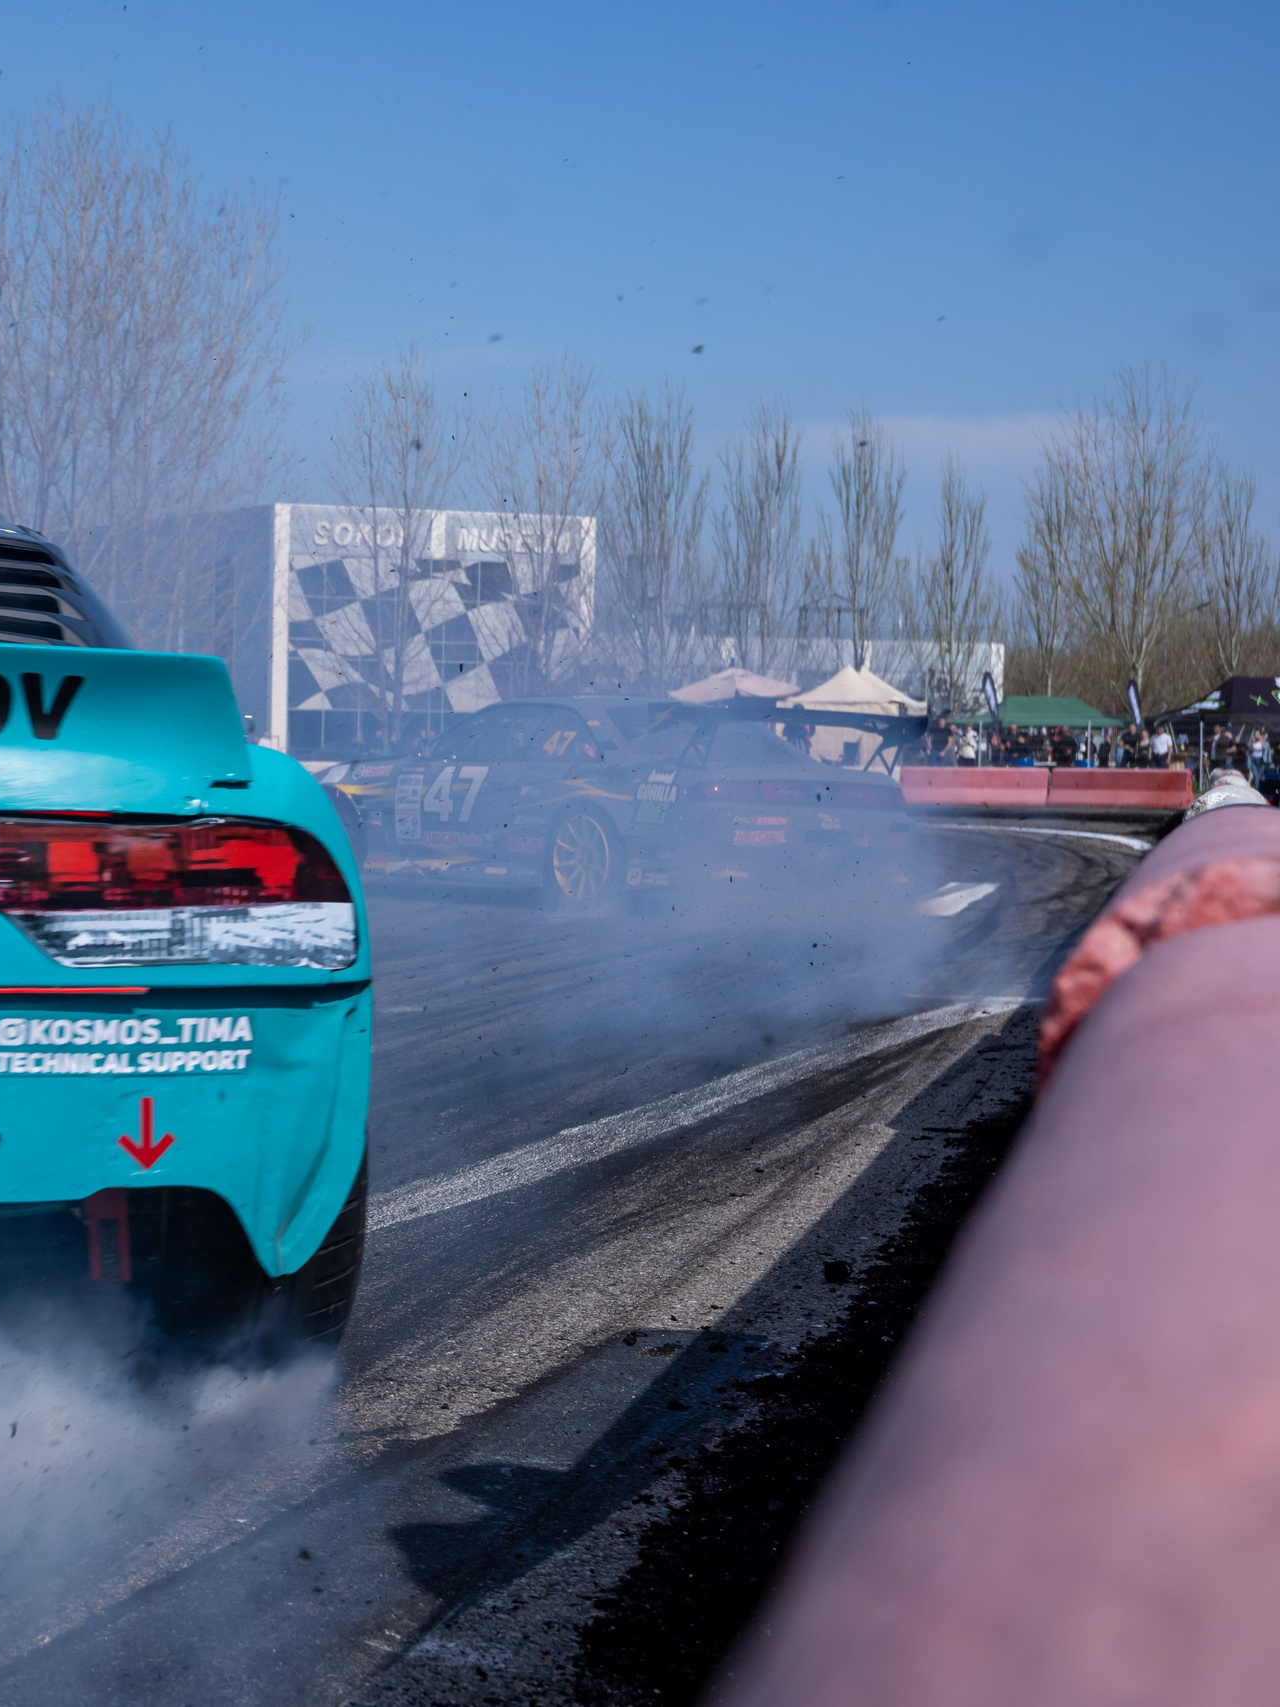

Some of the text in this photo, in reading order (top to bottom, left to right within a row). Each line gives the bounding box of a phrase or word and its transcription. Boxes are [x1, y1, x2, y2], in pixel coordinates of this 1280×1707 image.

[542, 729, 578, 756] 47
[423, 765, 490, 823] 47
[636, 783, 678, 803] GORILLA
[423, 831, 460, 847] ORIGIN
[137, 1048, 252, 1073] SUPPORT
